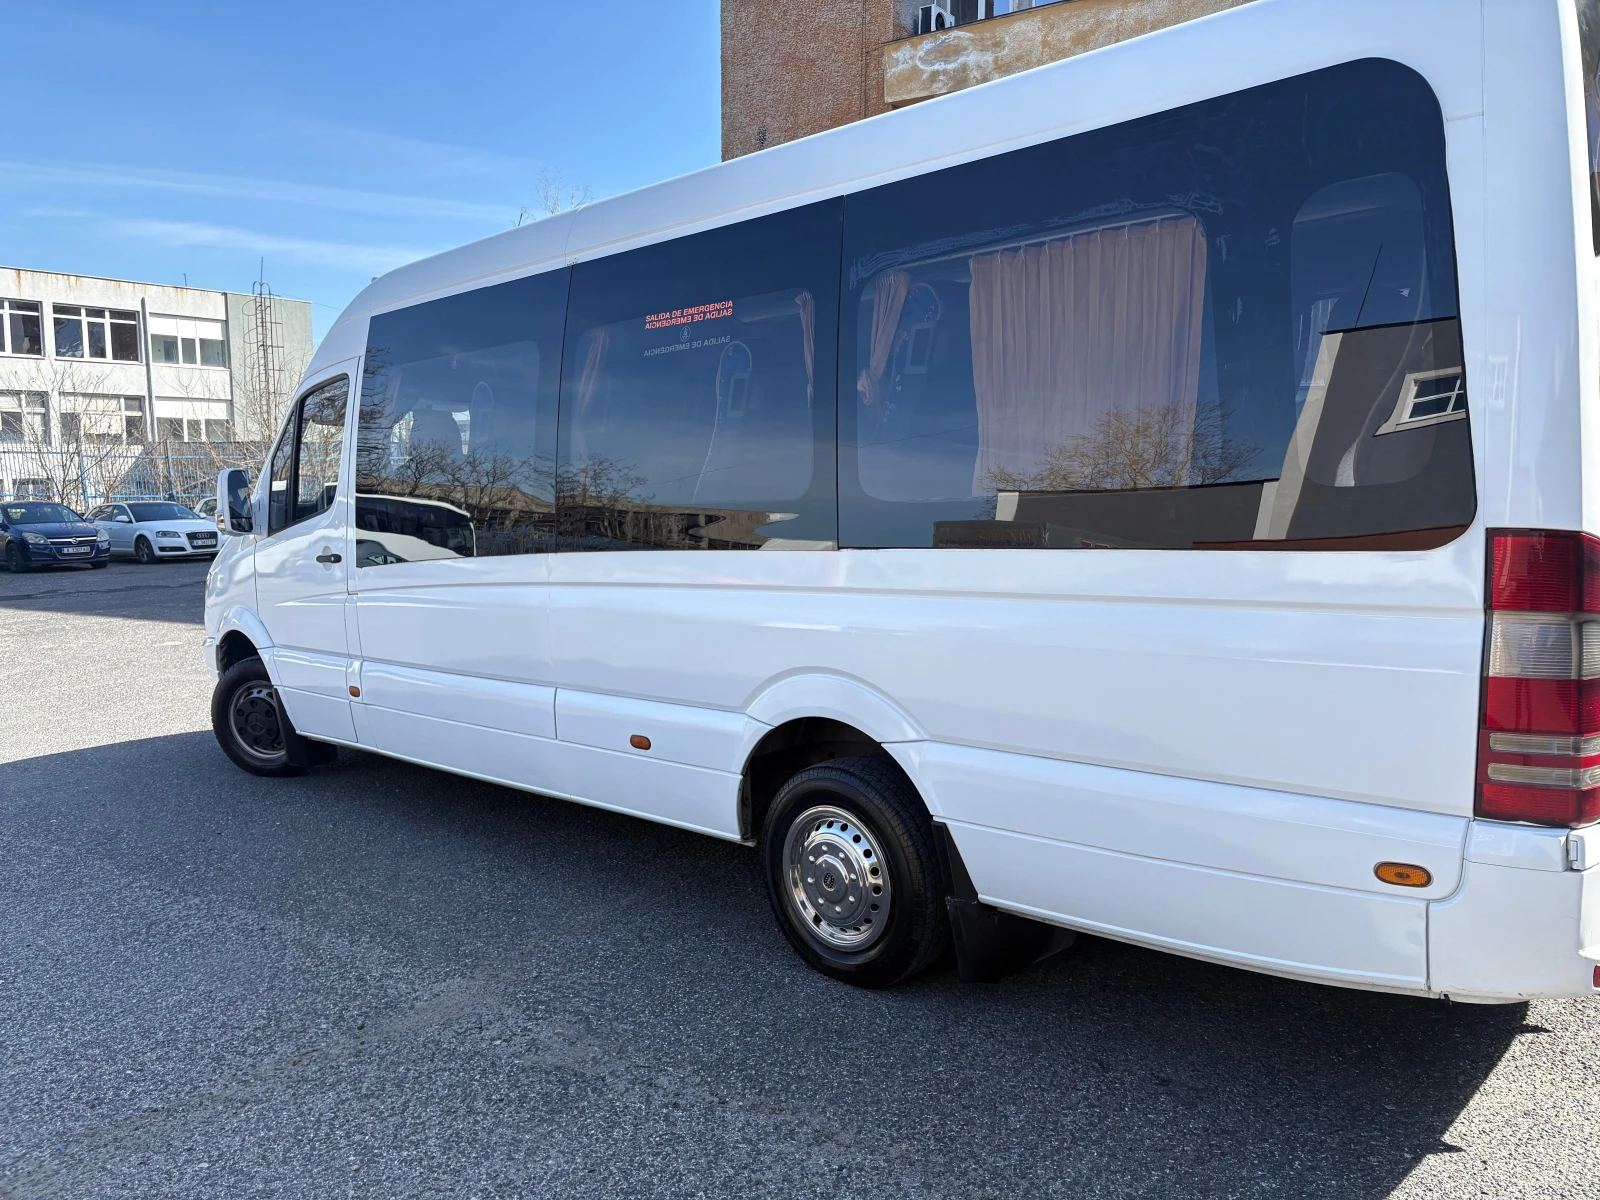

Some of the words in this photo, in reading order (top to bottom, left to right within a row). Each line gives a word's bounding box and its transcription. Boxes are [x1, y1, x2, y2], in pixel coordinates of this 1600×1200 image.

[645, 312, 671, 322] SALIDA
[672, 310, 682, 318] DE
[683, 300, 733, 316] EMERGENCIA
